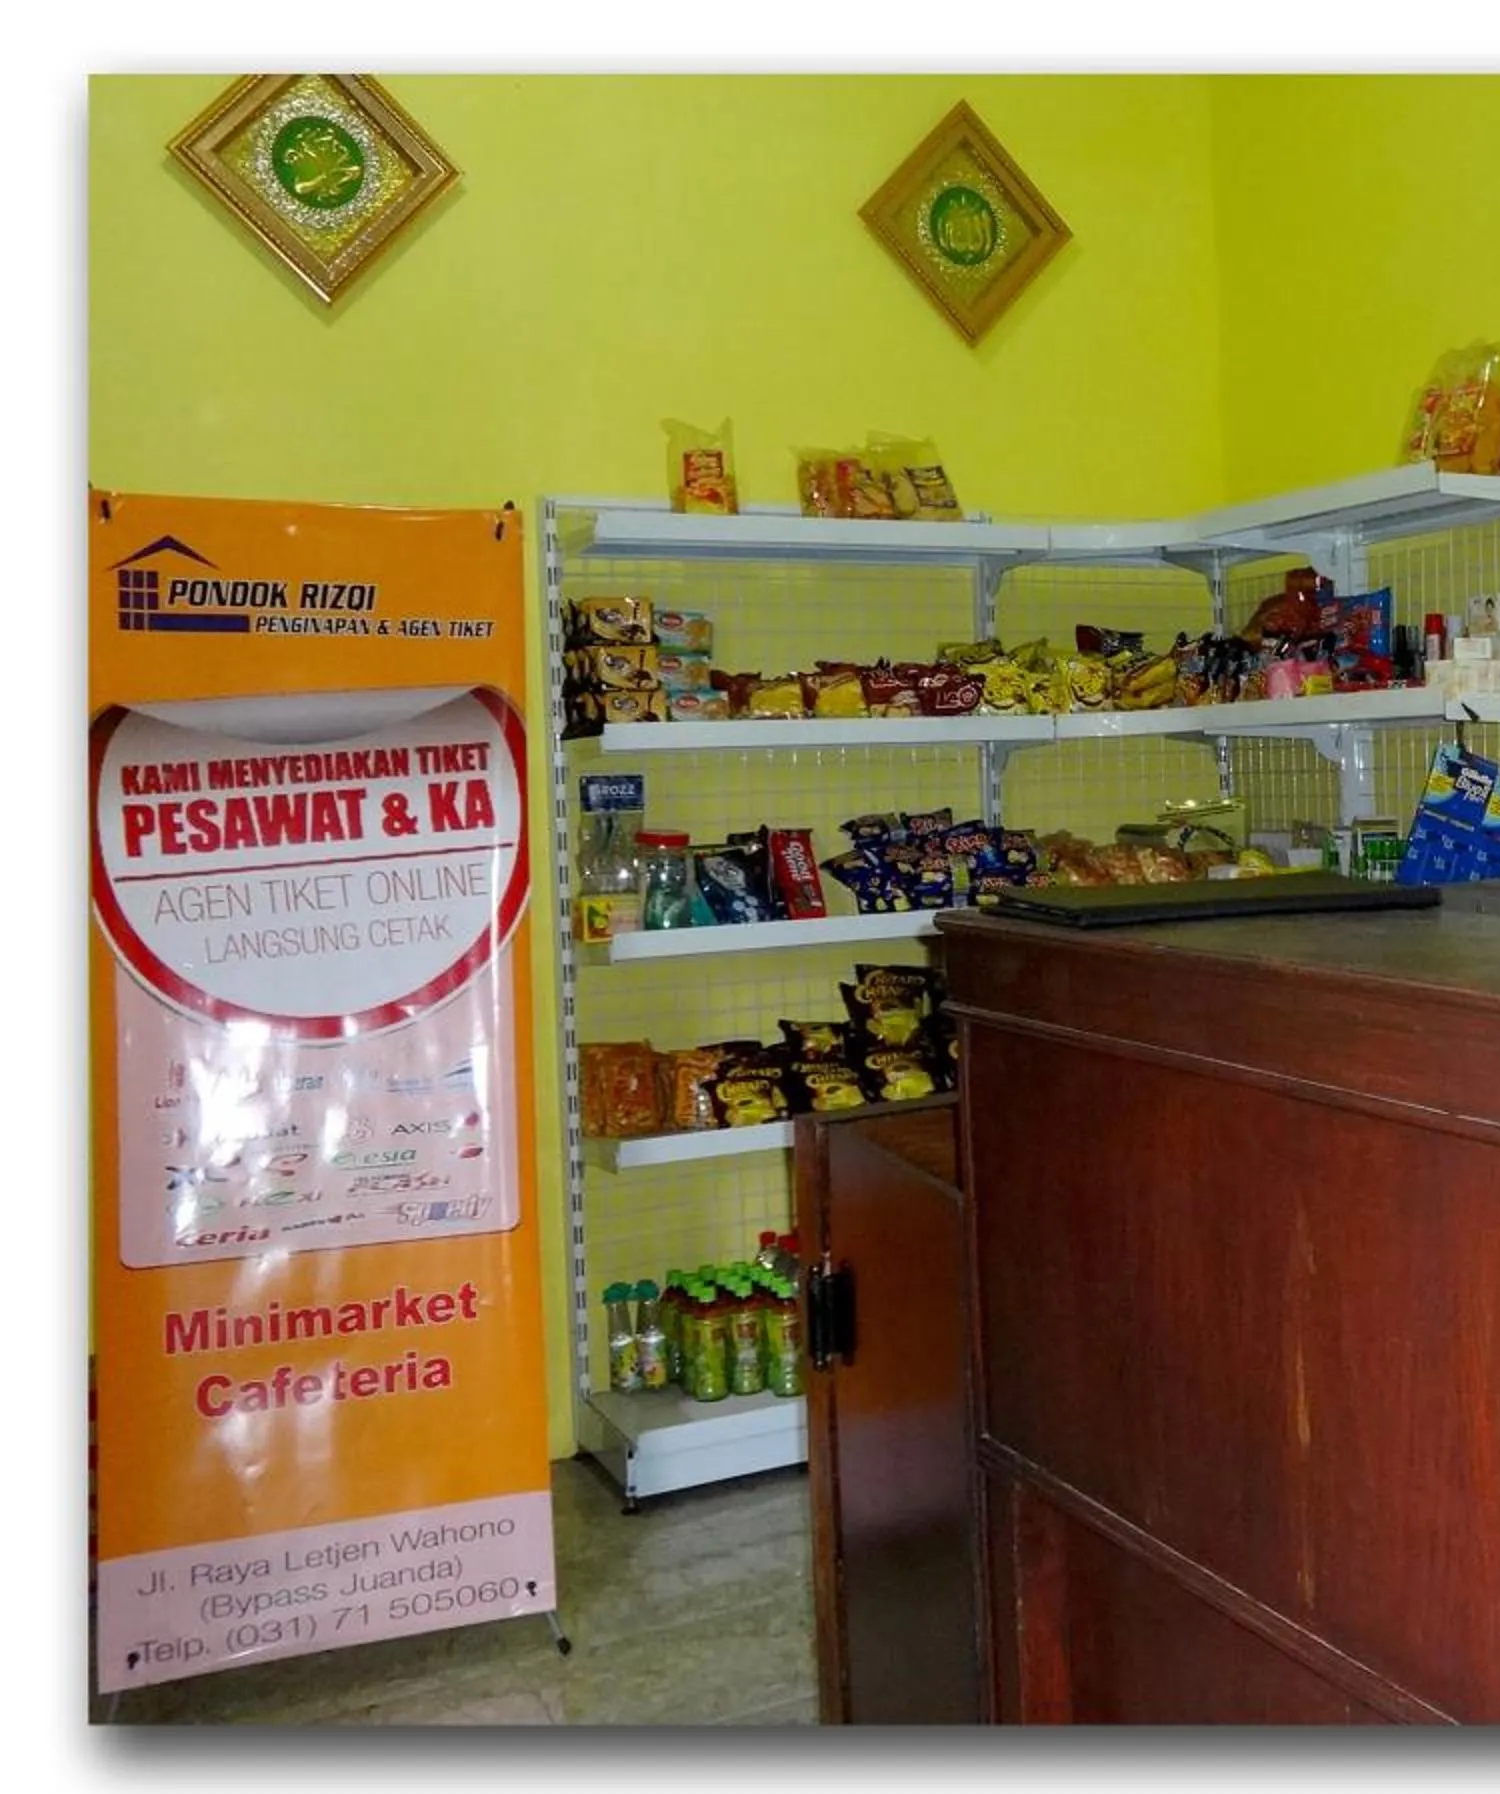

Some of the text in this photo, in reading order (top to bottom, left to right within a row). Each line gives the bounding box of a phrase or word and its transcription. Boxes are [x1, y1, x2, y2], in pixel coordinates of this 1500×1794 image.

[168, 579, 377, 612] PONDOK RIZQI
[254, 614, 494, 638] PENGINAPAN & AGEN TIKET
[121, 742, 491, 797] KAMI MENYEDIAKAN TIKET
[123, 778, 496, 858] PESAWAT & KA
[154, 862, 490, 926] AGEN TIKET ONLINE
[204, 914, 452, 966] LANGSUNG CETAK
[391, 1119, 452, 1136] AXIS
[165, 1282, 479, 1355] Minimarket
[196, 1351, 453, 1418] Cafeteria
[138, 1516, 516, 1597] Jl. Raya Letjen Wahono
[139, 1576, 521, 1667] Telp. (031) 71 505060
[200, 1555, 464, 1624] (Bypass Juanda)
